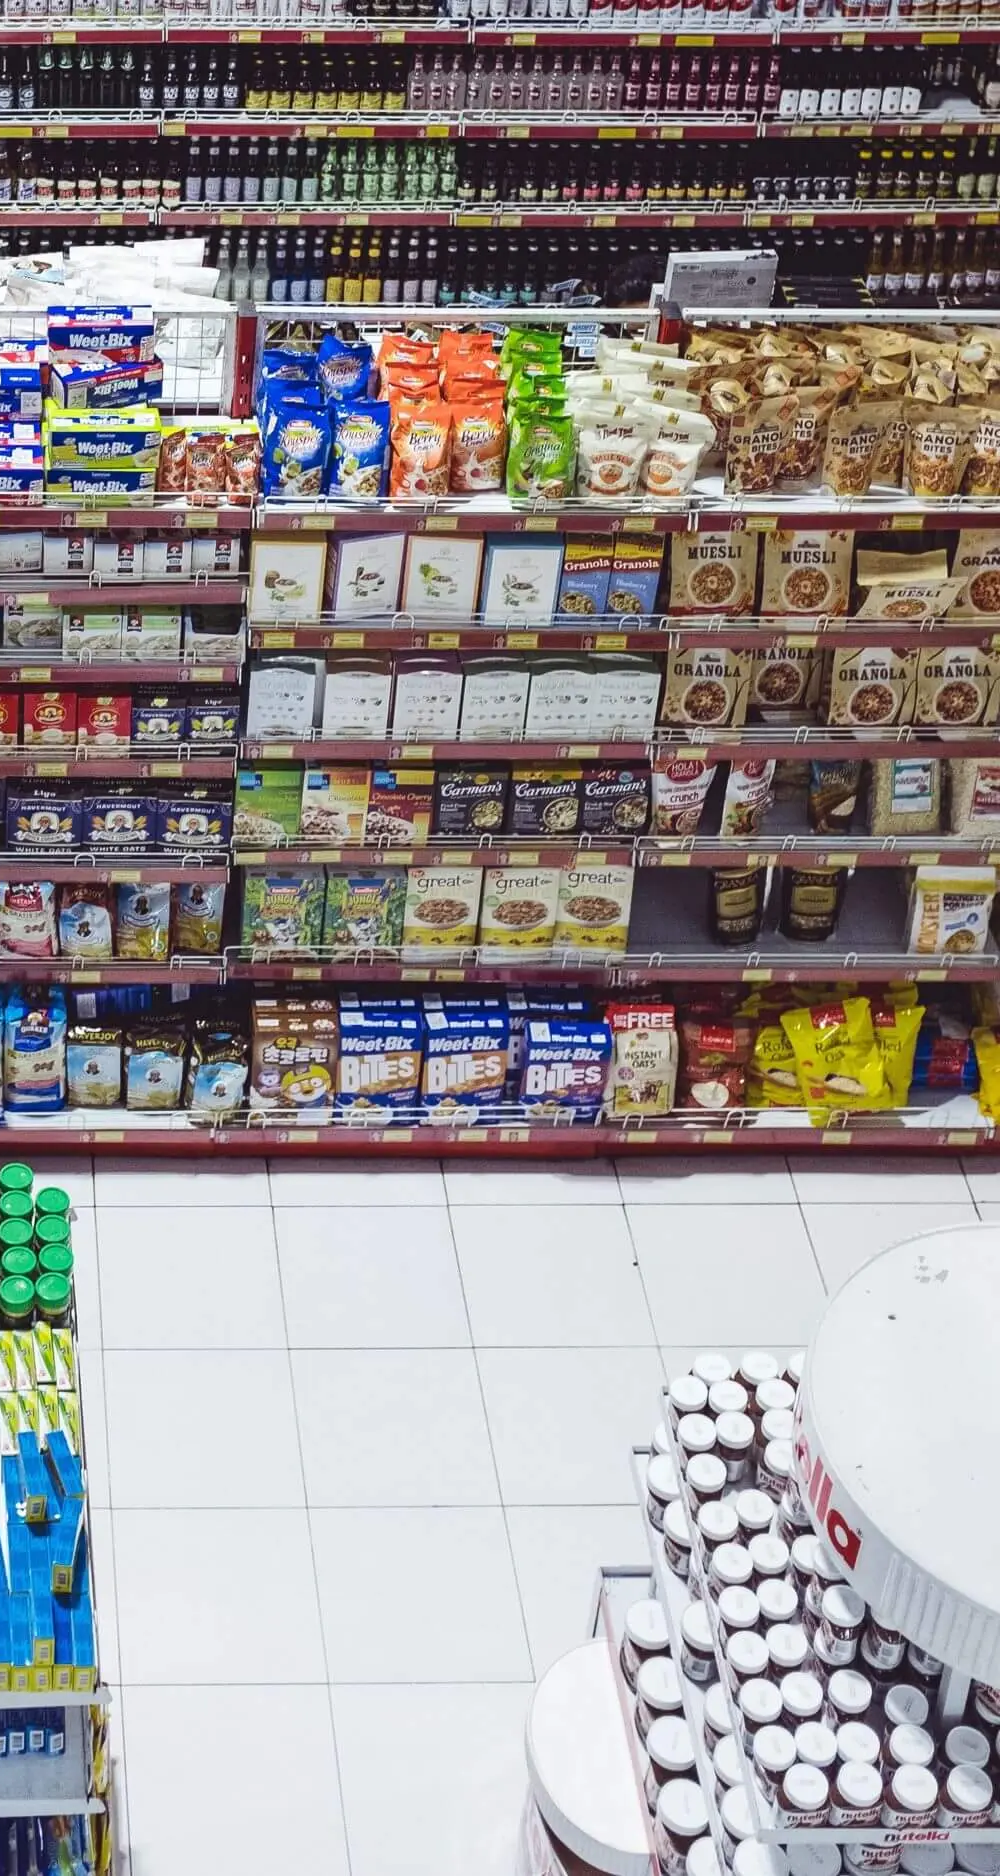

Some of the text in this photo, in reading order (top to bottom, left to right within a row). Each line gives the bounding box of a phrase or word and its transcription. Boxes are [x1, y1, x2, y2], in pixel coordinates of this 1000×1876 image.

[69, 333, 133, 347] Weet-Bix
[409, 432, 441, 447] Berry
[461, 430, 495, 443] Berry
[78, 441, 132, 454] Weet-Bix
[923, 444, 952, 453] BITES
[73, 480, 128, 492] Weet-Bix
[688, 545, 742, 560] MUESLI
[781, 550, 837, 564] MUESLI
[564, 558, 610, 572] Granola
[613, 560, 659, 570] Granola
[961, 556, 1000, 567] GRAN
[885, 589, 941, 598] MUESLI
[674, 663, 741, 678] GRANOLA
[839, 667, 907, 681] GRANOLA
[923, 664, 991, 678] GRANOLA
[33, 790, 56, 799] Ligo
[441, 781, 503, 797] Carman's
[515, 782, 577, 797] Carman's
[585, 781, 646, 796] Carman's
[670, 792, 700, 803] crunch
[21, 805, 66, 813] HAVERMOUT
[170, 806, 215, 814] HAVERMOUT
[416, 874, 461, 893] great
[496, 874, 539, 894] great
[568, 872, 613, 889] great
[627, 1013, 673, 1028] FREE
[341, 1036, 415, 1052] Weet-Bix
[429, 1036, 502, 1052] Weet-Bix
[529, 1048, 602, 1061] Weet-Bix
[625, 1051, 662, 1060] INSTANT
[632, 1060, 656, 1068] OATS
[884, 1831, 950, 1843] nutella
